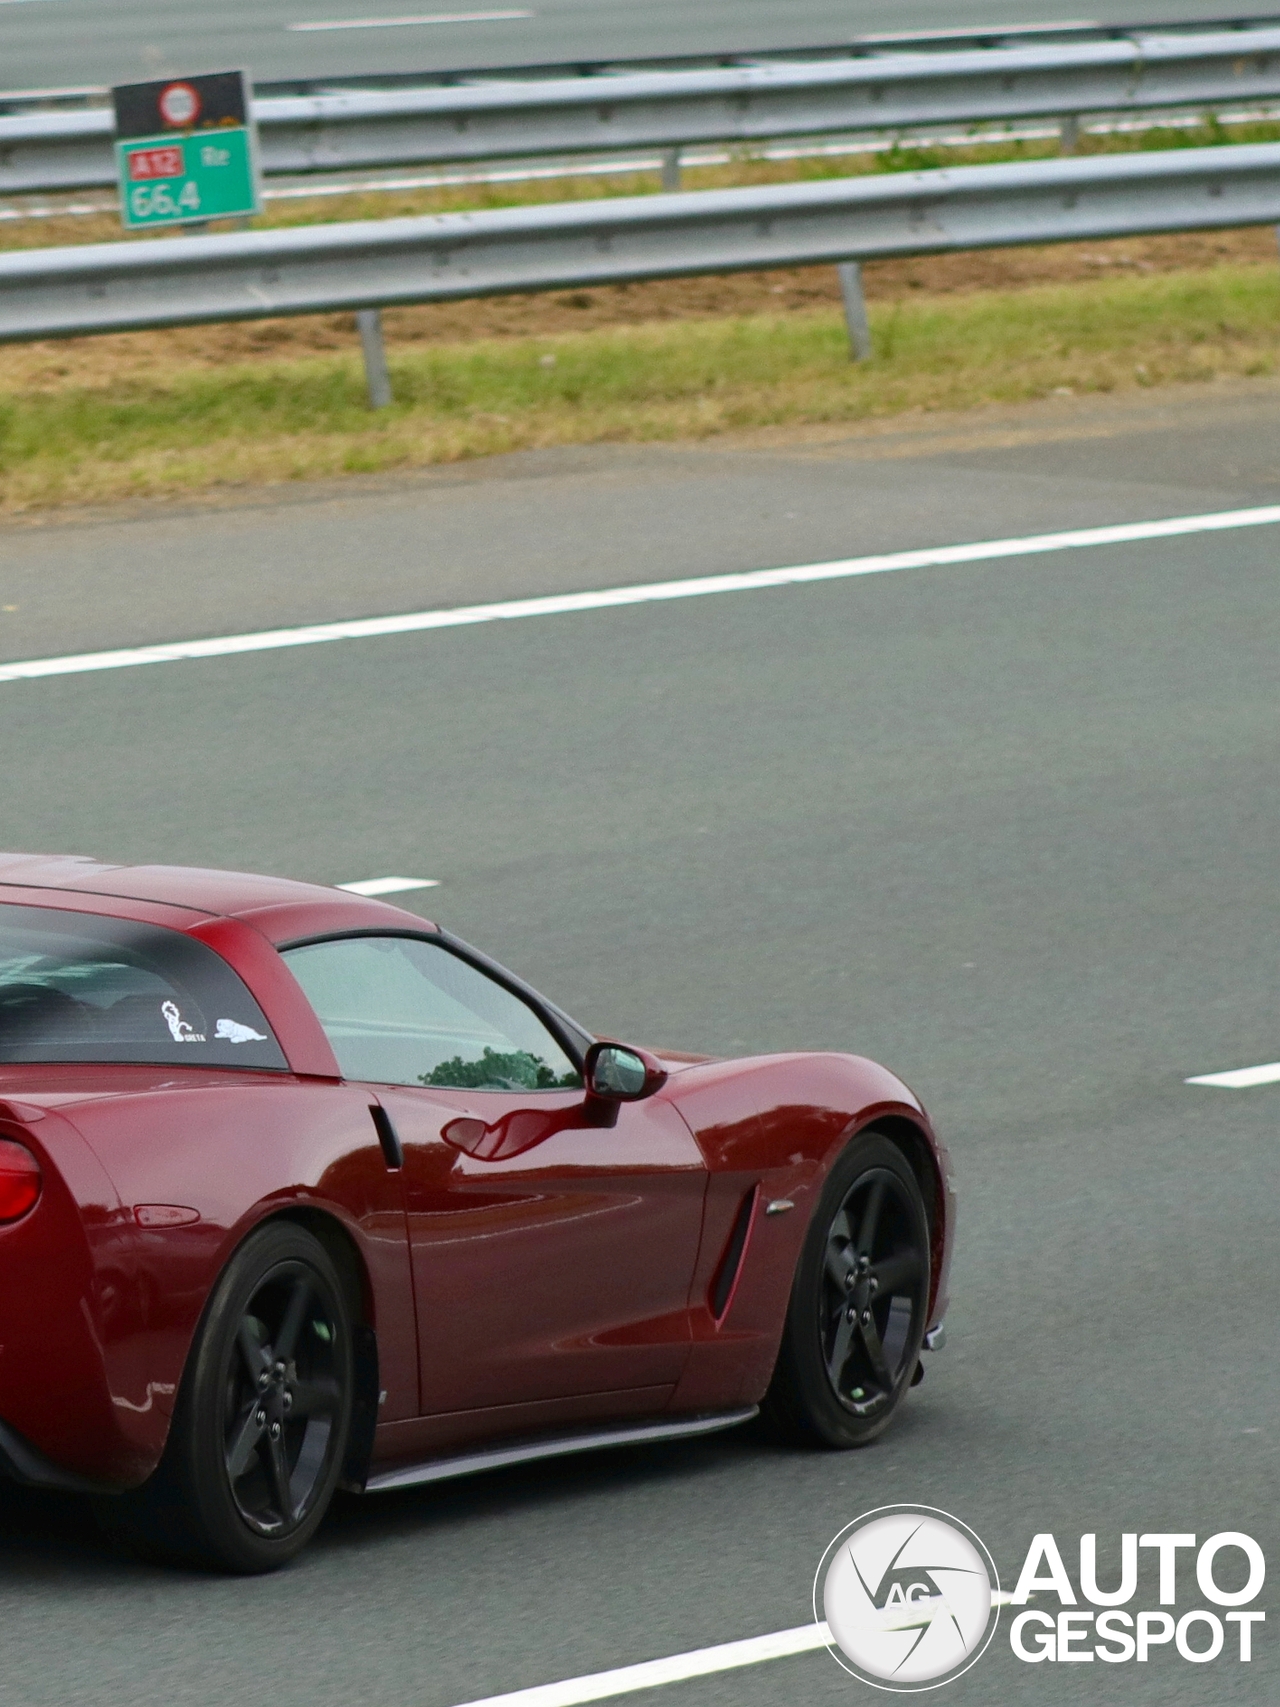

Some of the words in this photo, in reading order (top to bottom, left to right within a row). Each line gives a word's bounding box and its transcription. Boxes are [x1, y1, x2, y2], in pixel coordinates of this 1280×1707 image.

[134, 152, 177, 174] A12
[201, 146, 230, 166] Re
[131, 181, 201, 217] 66,4
